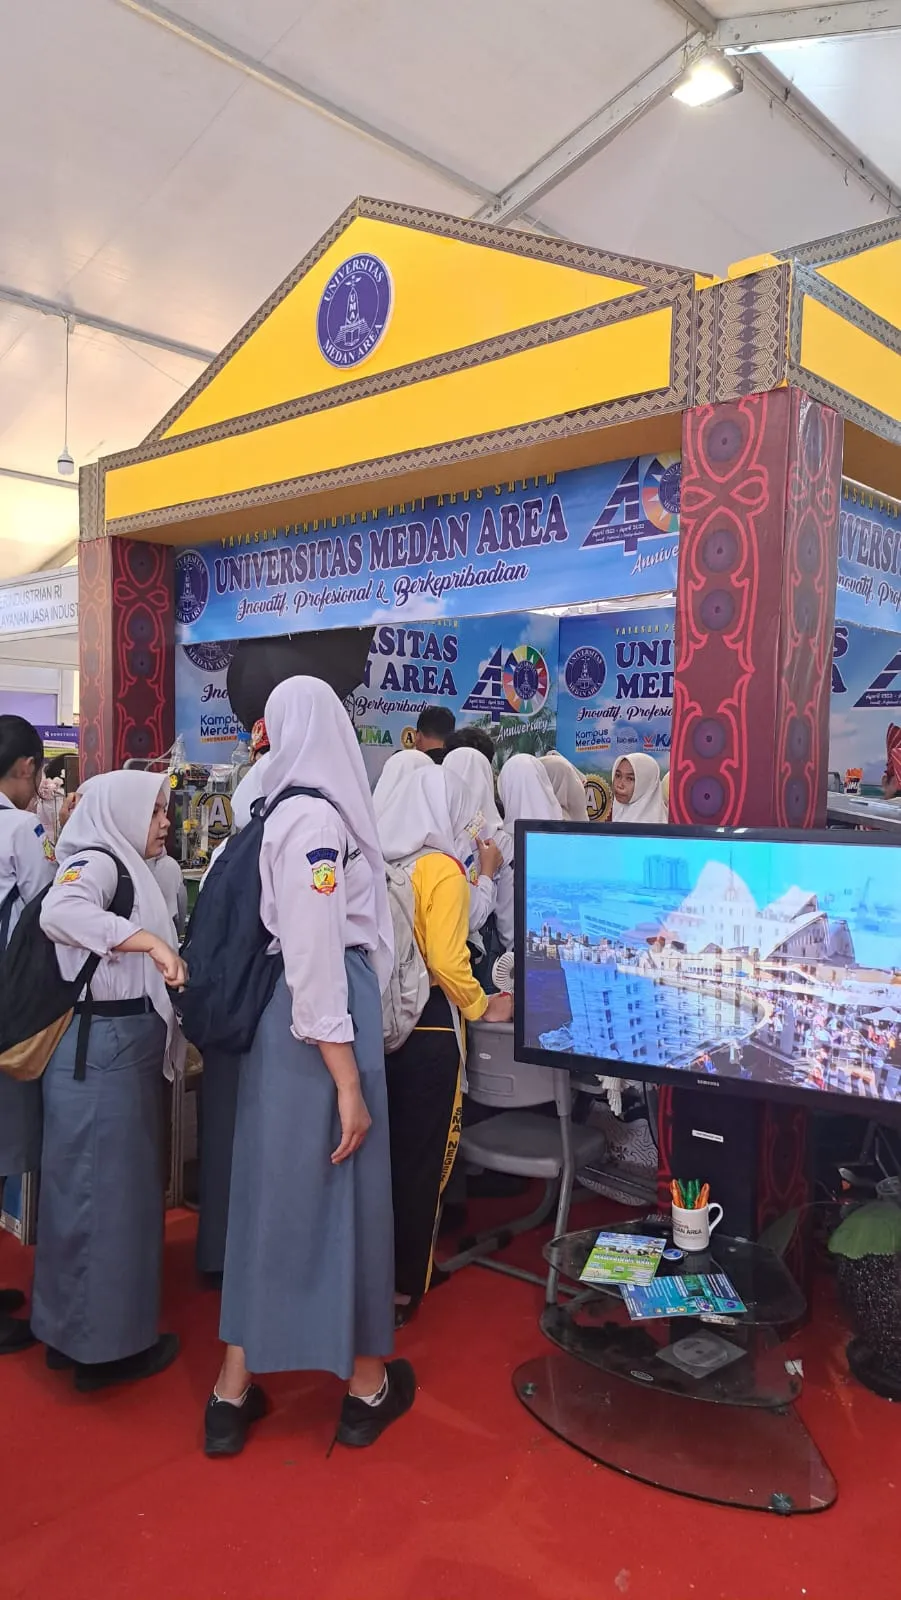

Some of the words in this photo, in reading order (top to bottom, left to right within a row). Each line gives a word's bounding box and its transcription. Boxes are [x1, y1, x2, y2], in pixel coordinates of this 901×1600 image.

[324, 258, 384, 301] UNIVERSITAS
[323, 339, 355, 363] MEDAN
[358, 324, 383, 358] AREA
[844, 484, 874, 510] ASAN
[221, 526, 278, 548] YAYASAN
[285, 507, 379, 538] PENDIDIKAN
[838, 511, 901, 575] IVERSI
[214, 532, 362, 594] UNIVERSITAS
[368, 512, 471, 573] MEDAN
[475, 494, 569, 555] AREA
[630, 544, 679, 576] Annive
[236, 590, 289, 622] Inovatif,
[293, 580, 374, 614] Profesional
[376, 580, 390, 604] &
[393, 559, 529, 608] Berkepribadian
[838, 573, 874, 604] novatif,
[615, 639, 674, 669] UNI
[201, 683, 231, 702] Ino
[380, 662, 458, 696] AREA
[615, 672, 674, 700] MED
[201, 714, 239, 727] Kampu
[355, 695, 430, 716] Berkepribadi
[626, 703, 673, 720] Profesio
[496, 719, 551, 742] Anniversary
[209, 797, 230, 829] A
[586, 787, 600, 813] A
